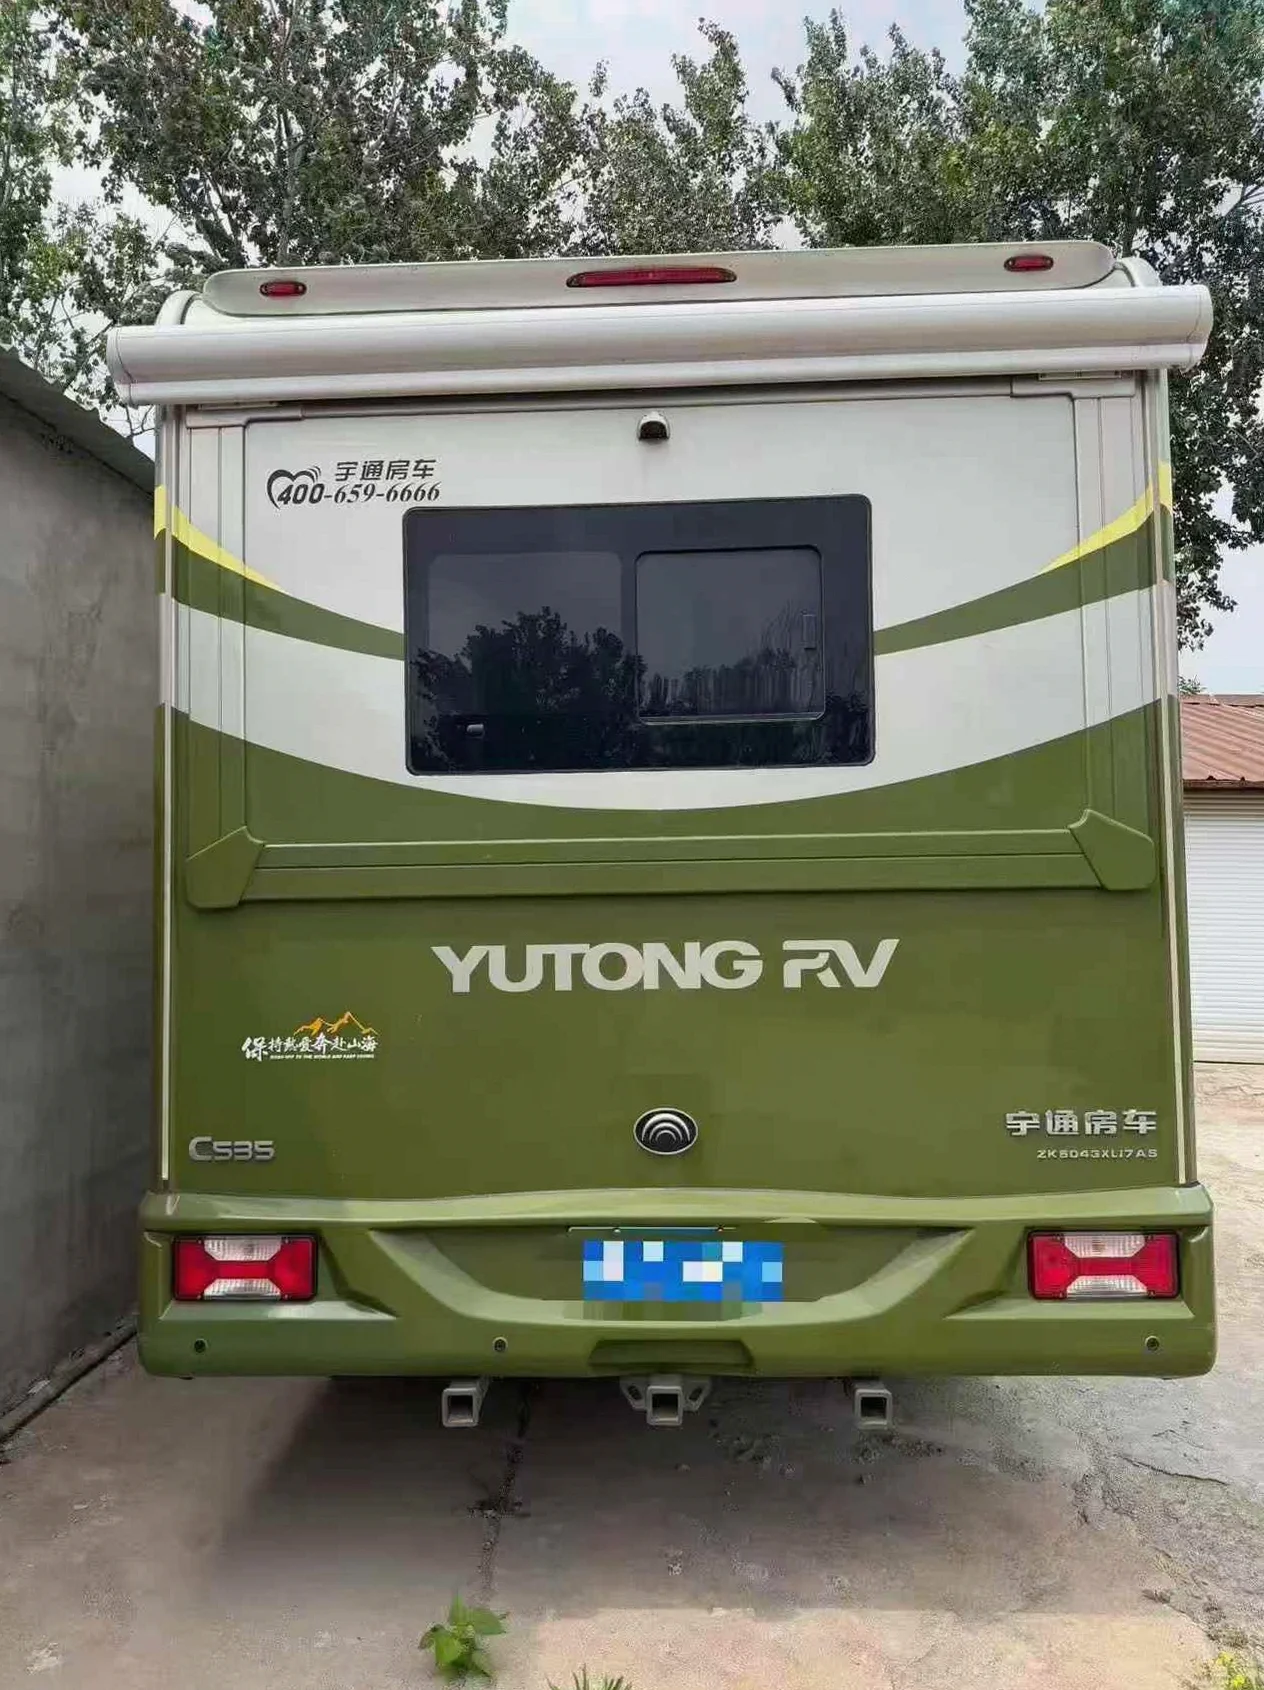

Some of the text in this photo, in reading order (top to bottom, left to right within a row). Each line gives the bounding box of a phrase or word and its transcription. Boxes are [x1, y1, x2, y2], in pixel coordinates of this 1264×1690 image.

[335, 459, 437, 482] 宇通房车
[277, 482, 442, 504] 400-659-6666
[431, 938, 901, 993] YUTONG RV
[1005, 1108, 1157, 1136] 宇通房车
[188, 1136, 275, 1161] C535
